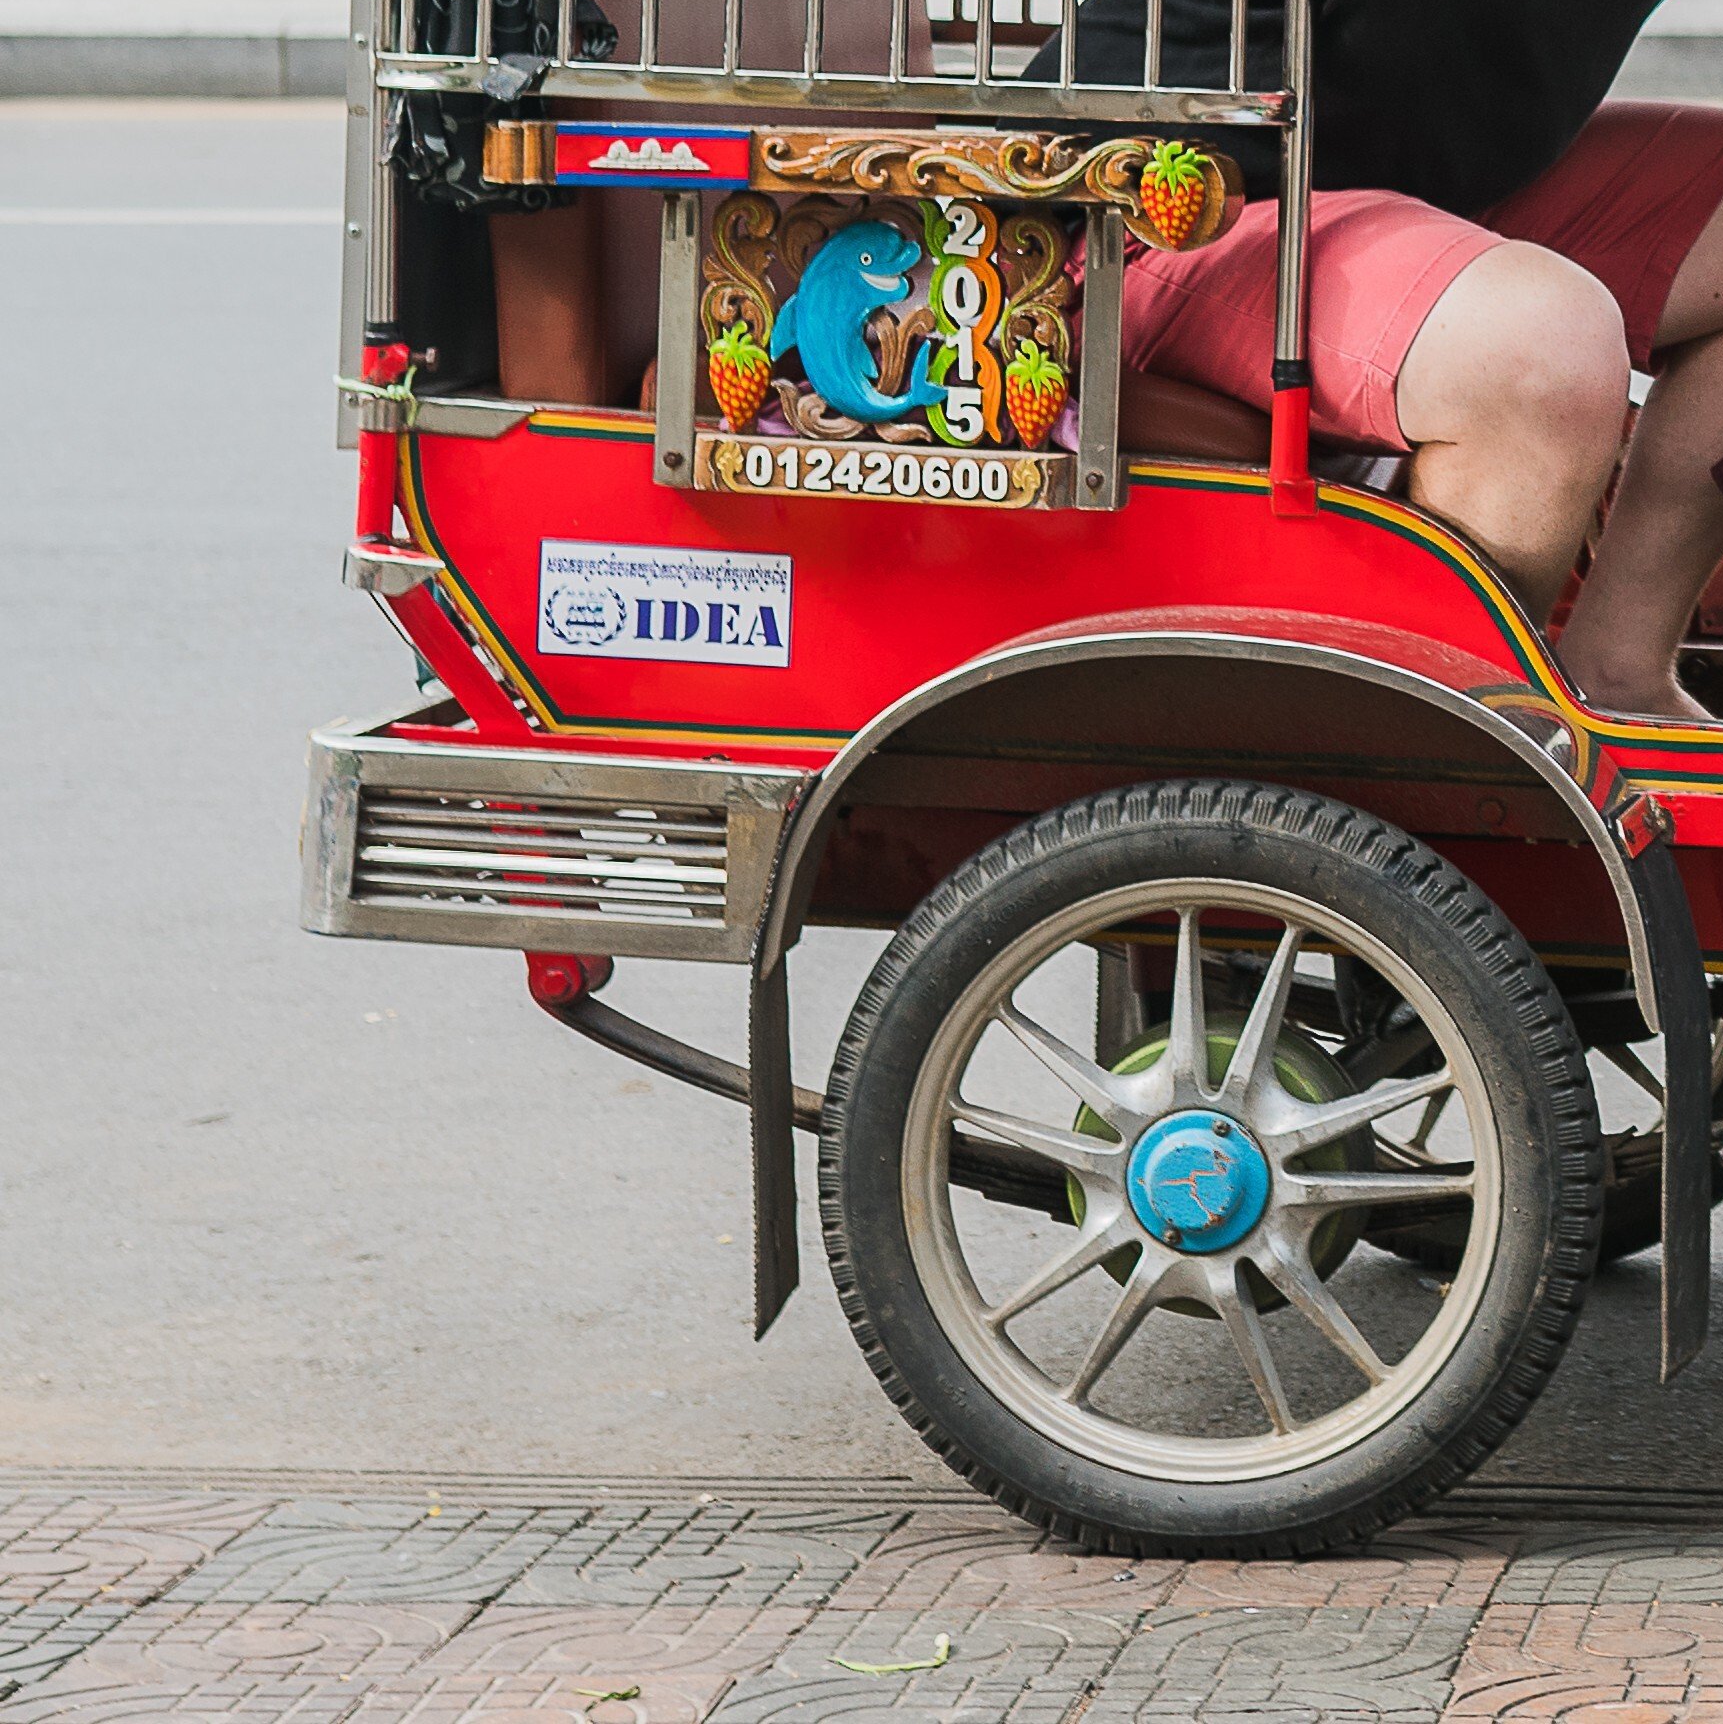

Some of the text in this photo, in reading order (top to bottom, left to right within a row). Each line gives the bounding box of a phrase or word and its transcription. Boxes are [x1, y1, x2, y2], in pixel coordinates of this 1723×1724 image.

[940, 203, 985, 441] 2015
[745, 445, 1008, 500] 012420600
[633, 598, 784, 648] IDEA
